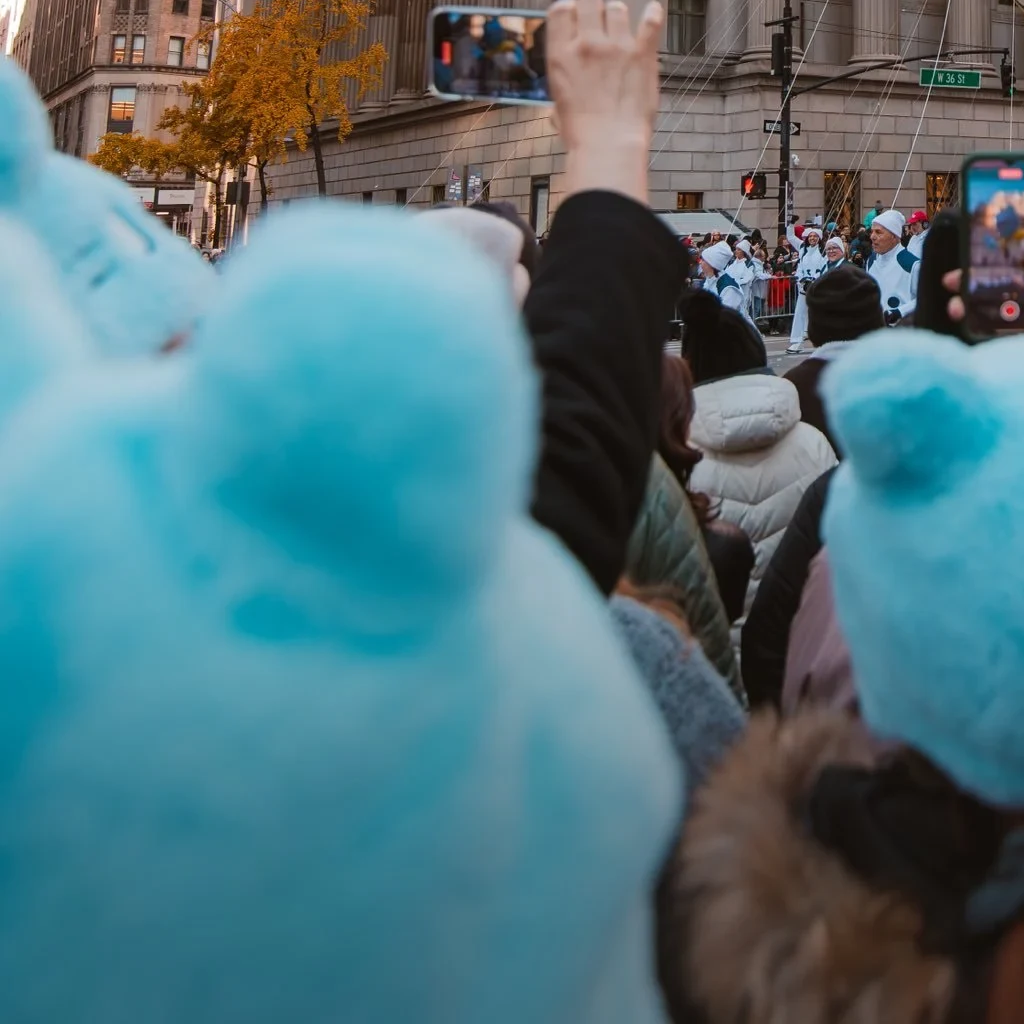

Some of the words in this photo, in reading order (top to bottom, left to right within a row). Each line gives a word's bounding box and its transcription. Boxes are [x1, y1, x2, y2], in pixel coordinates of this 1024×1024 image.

[937, 72, 944, 83] W
[946, 73, 956, 84] 36
[957, 73, 966, 84] St
